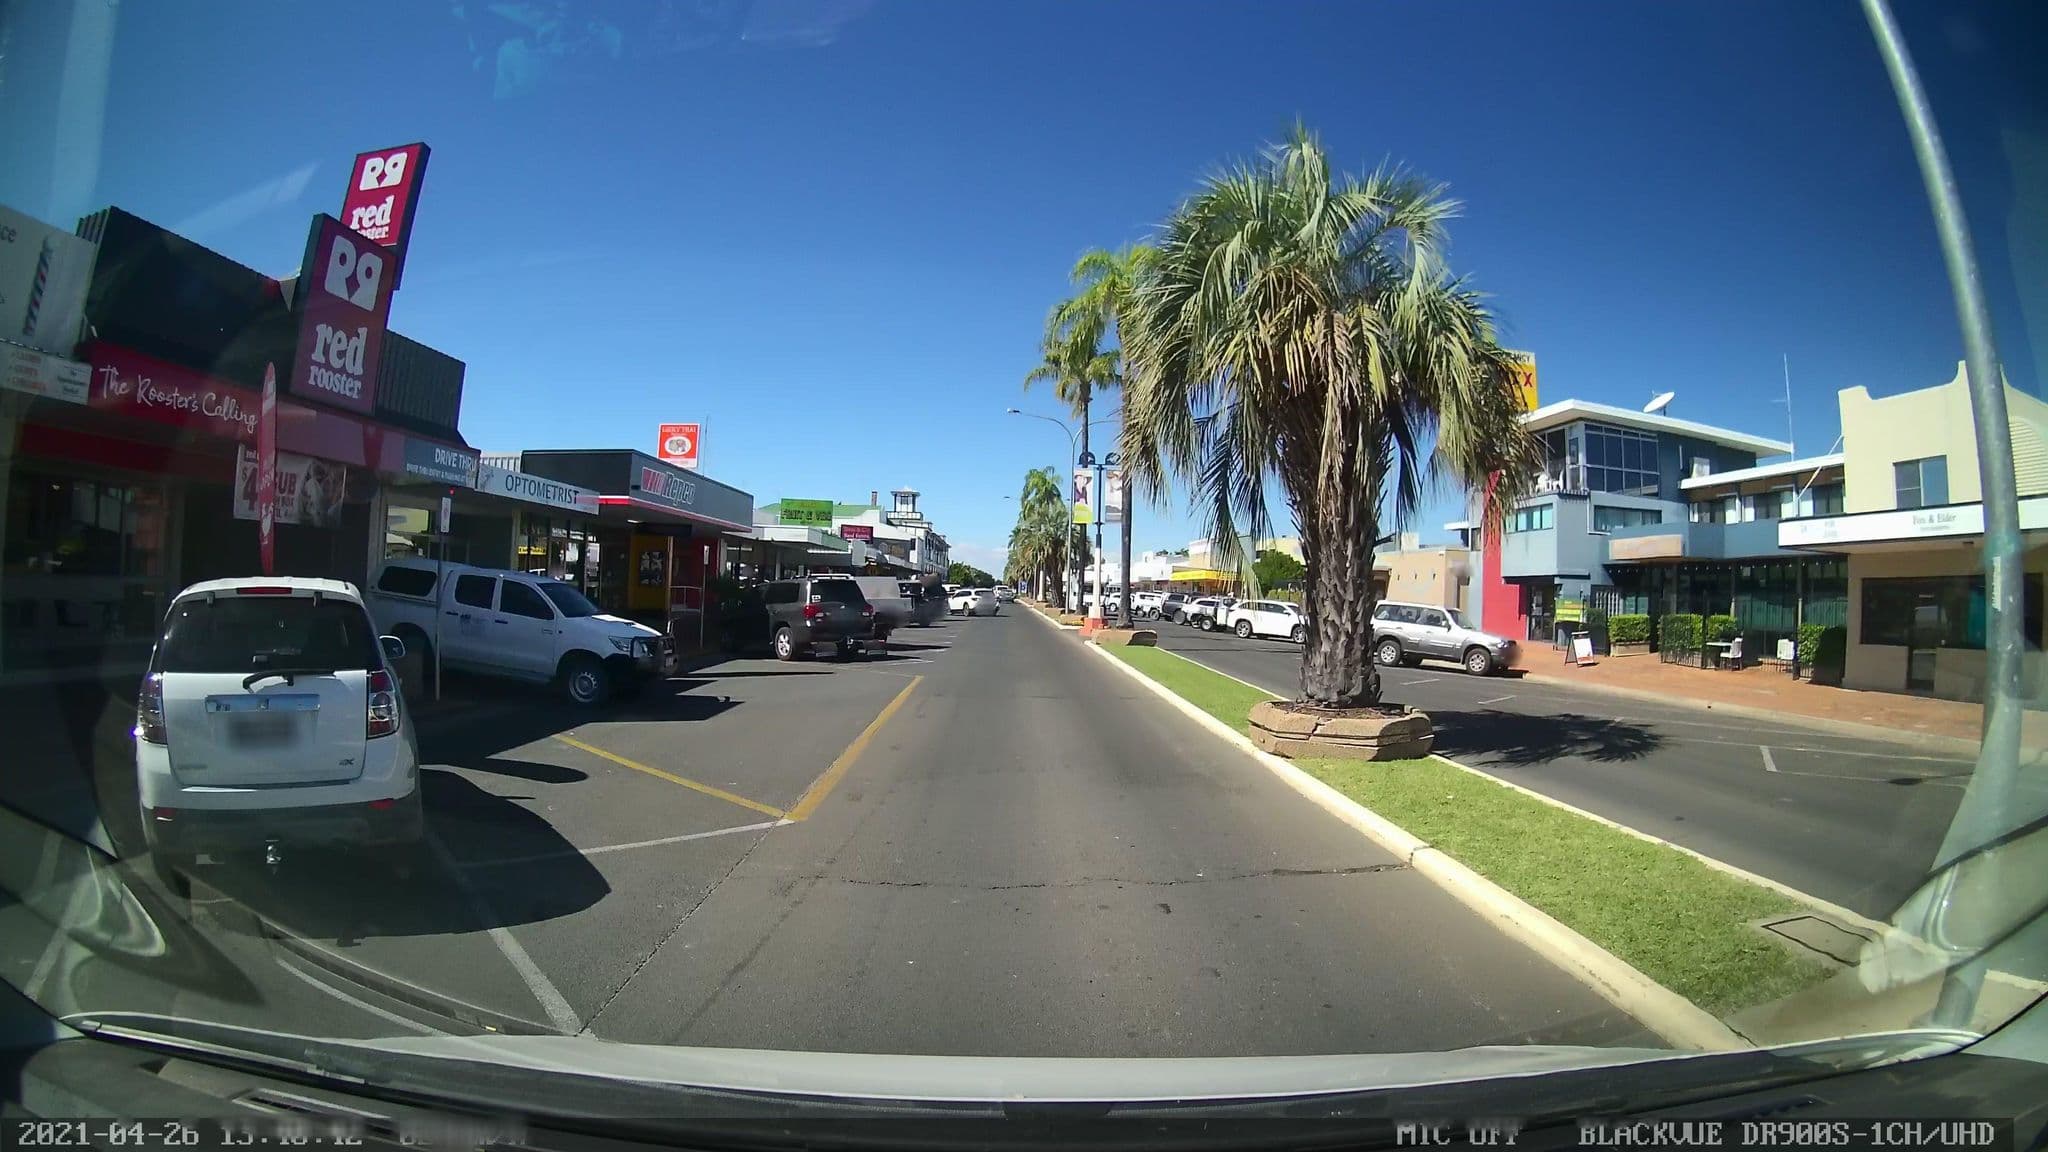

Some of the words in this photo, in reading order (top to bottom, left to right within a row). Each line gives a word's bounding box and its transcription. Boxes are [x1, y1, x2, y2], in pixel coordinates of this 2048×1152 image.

[350, 195, 395, 230] red
[0, 225, 17, 242] ce
[357, 226, 389, 240] oster
[311, 323, 368, 375] red
[308, 365, 362, 399] rooster
[99, 365, 130, 399] The
[137, 375, 199, 412] Rooster's
[202, 391, 258, 434] Calling
[434, 447, 458, 468] DRIVE
[459, 453, 477, 472] THRU
[275, 470, 297, 496] UB
[504, 474, 580, 505] OPTOMETRIST
